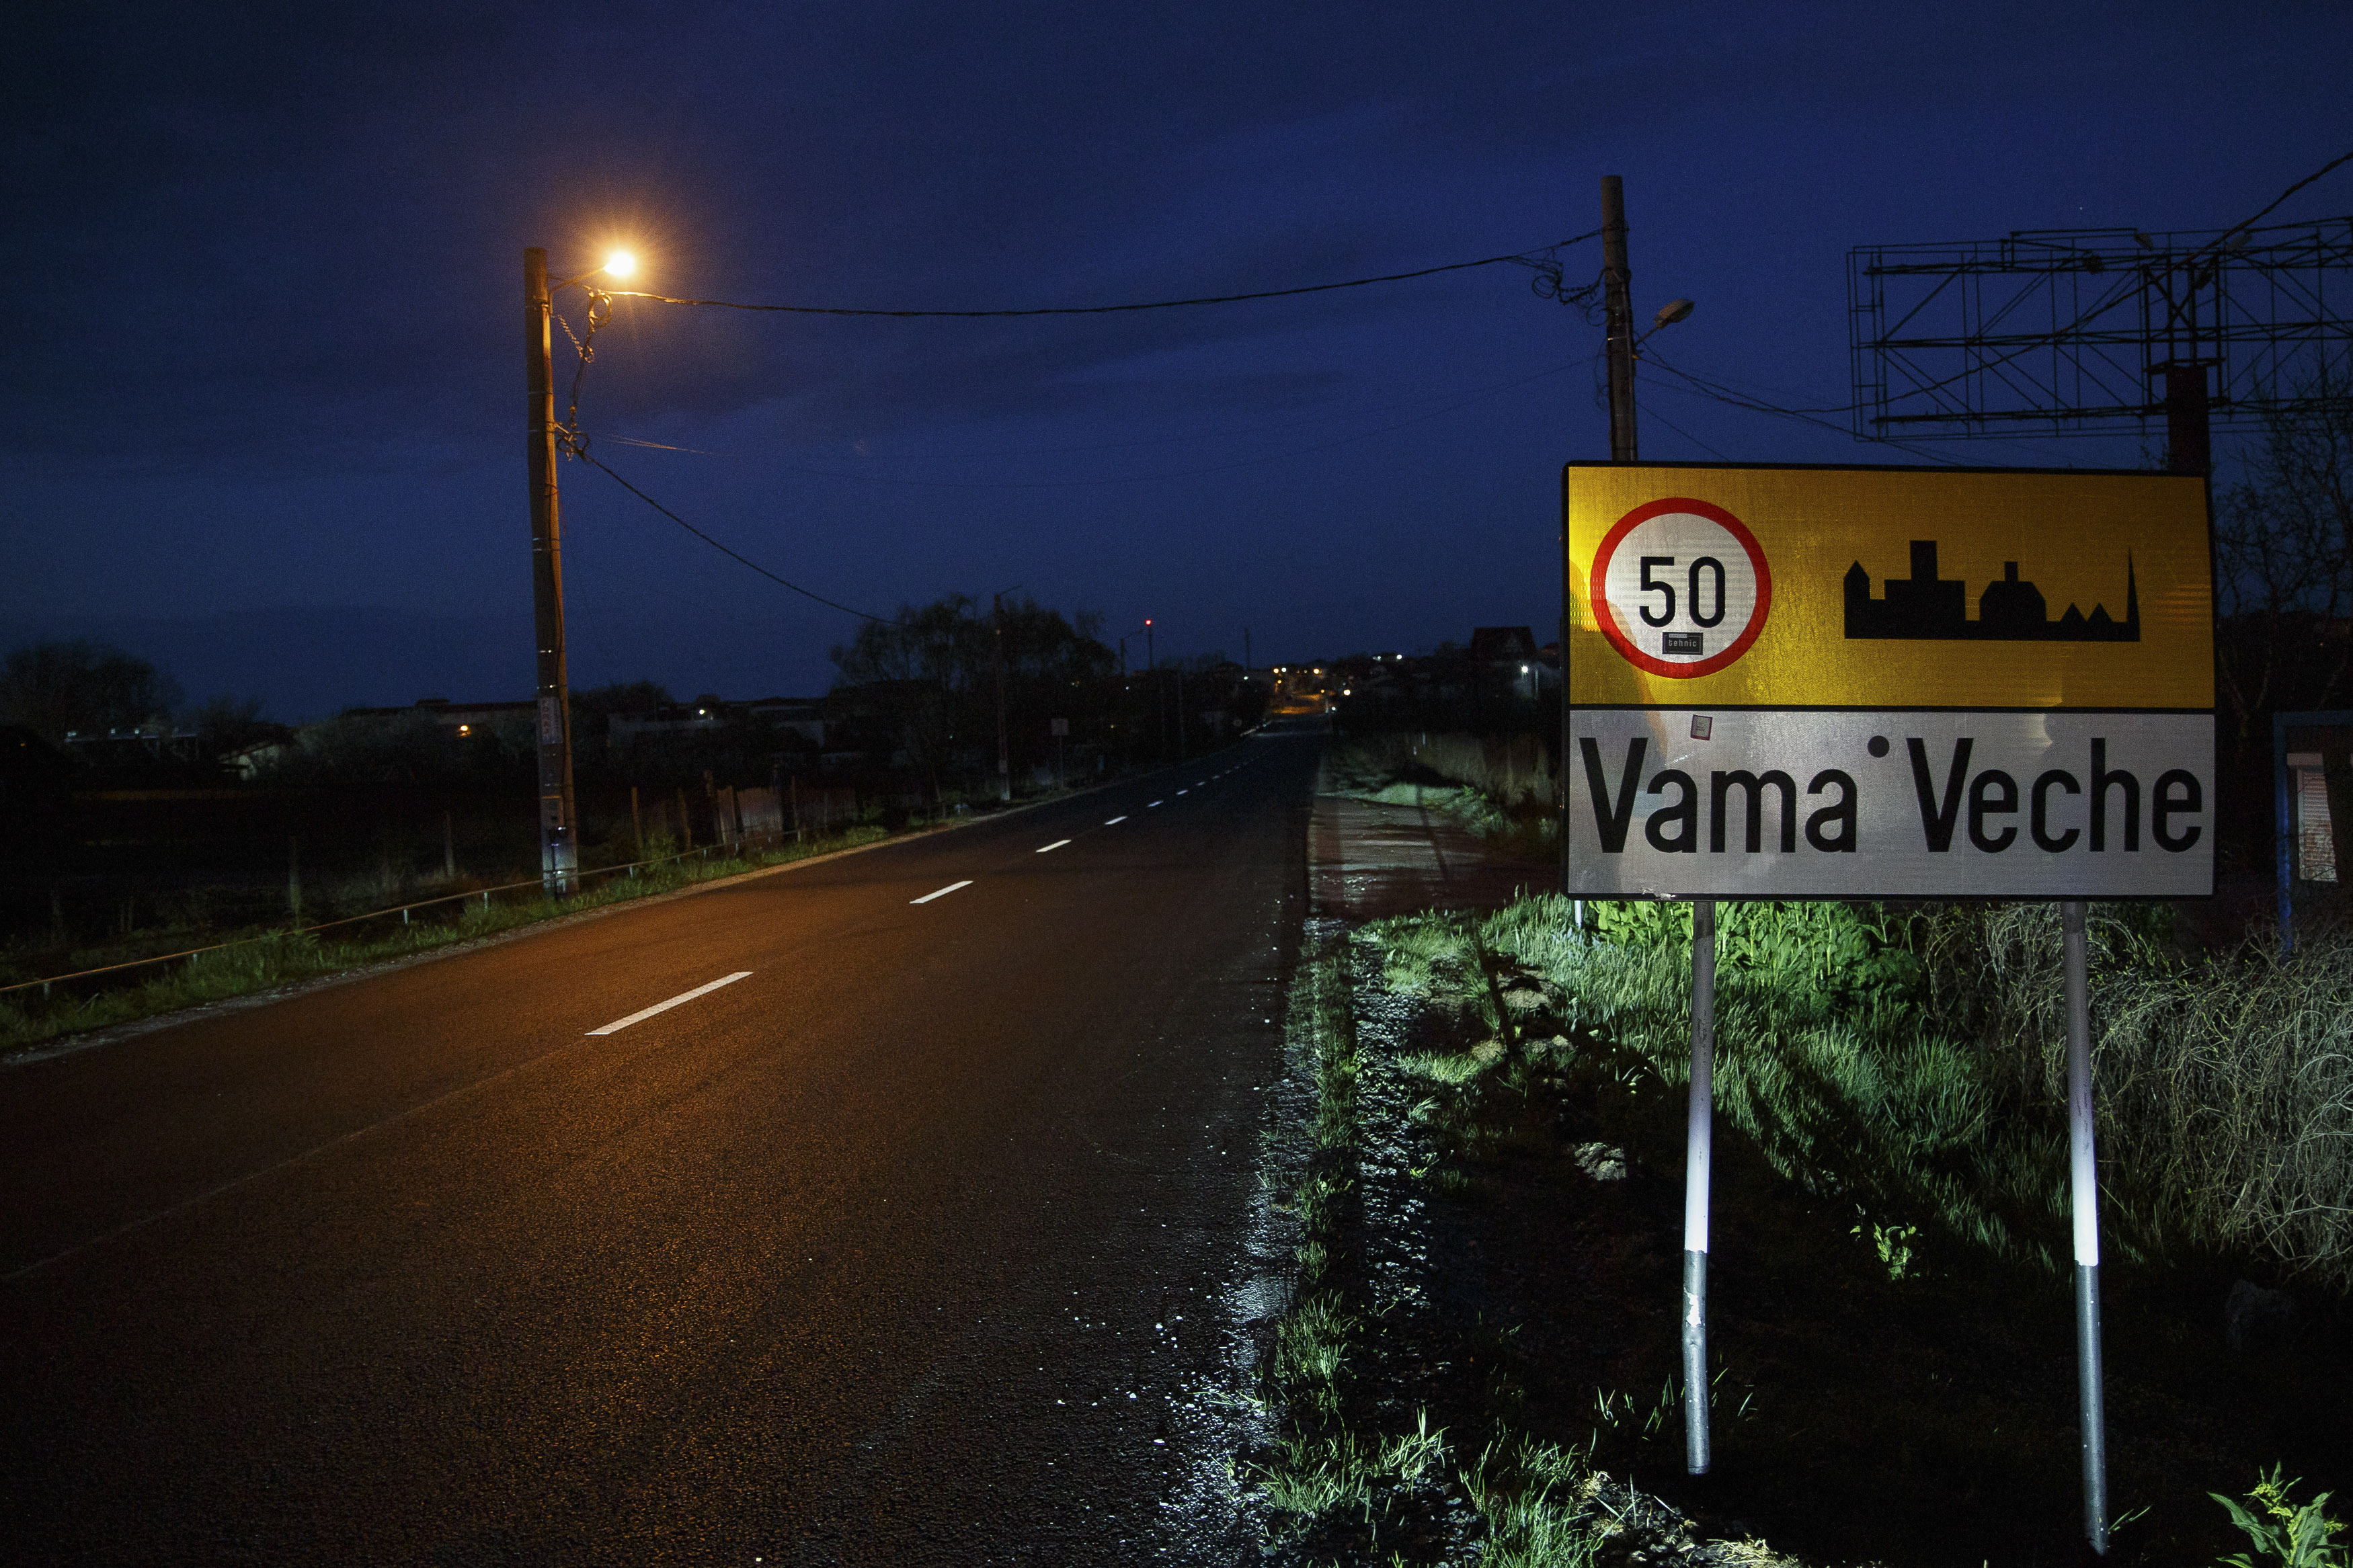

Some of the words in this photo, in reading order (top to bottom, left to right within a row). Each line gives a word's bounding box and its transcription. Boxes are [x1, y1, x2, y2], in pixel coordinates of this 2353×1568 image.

[1639, 556, 1726, 628] 50
[1668, 638, 1698, 647] tehnic
[1579, 737, 1858, 854] Vama
[1905, 737, 2203, 854] Veche
